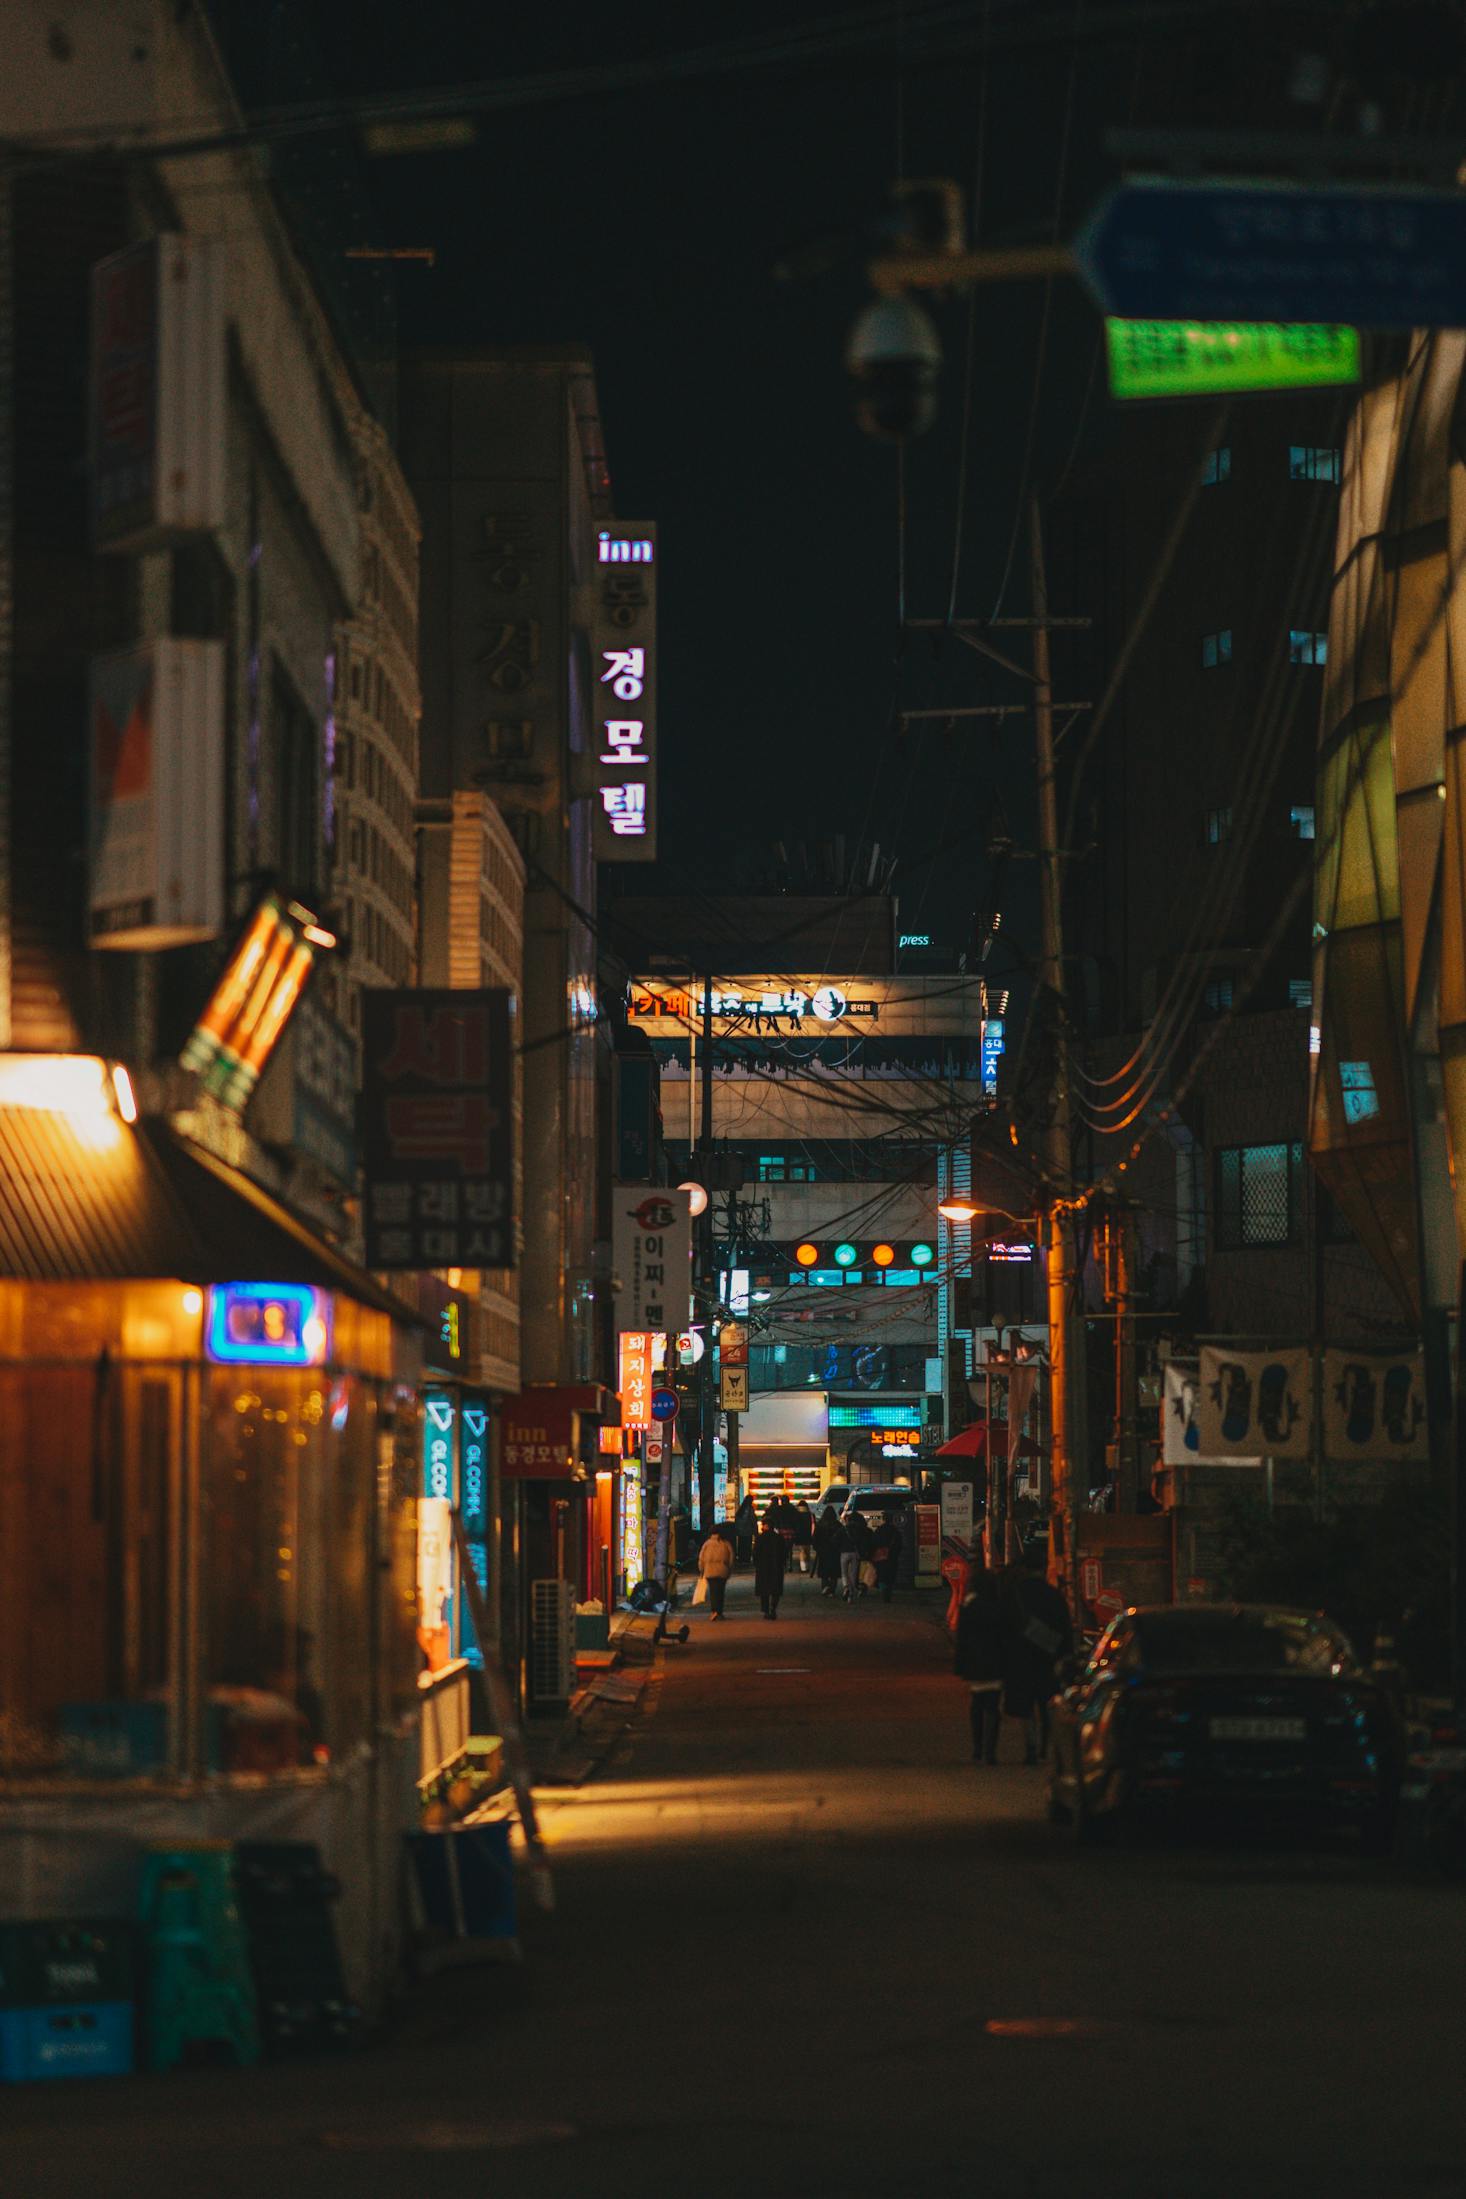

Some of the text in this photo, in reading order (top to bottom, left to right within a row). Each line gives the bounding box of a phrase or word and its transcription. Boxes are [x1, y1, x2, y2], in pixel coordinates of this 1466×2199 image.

[599, 531, 653, 563] inn
[899, 936, 929, 948] press
[378, 1004, 499, 1176] 세탁
[628, 1335, 645, 1419] 돼지상회
[507, 1423, 547, 1442] inn
[871, 1431, 920, 1444] 노래연습
